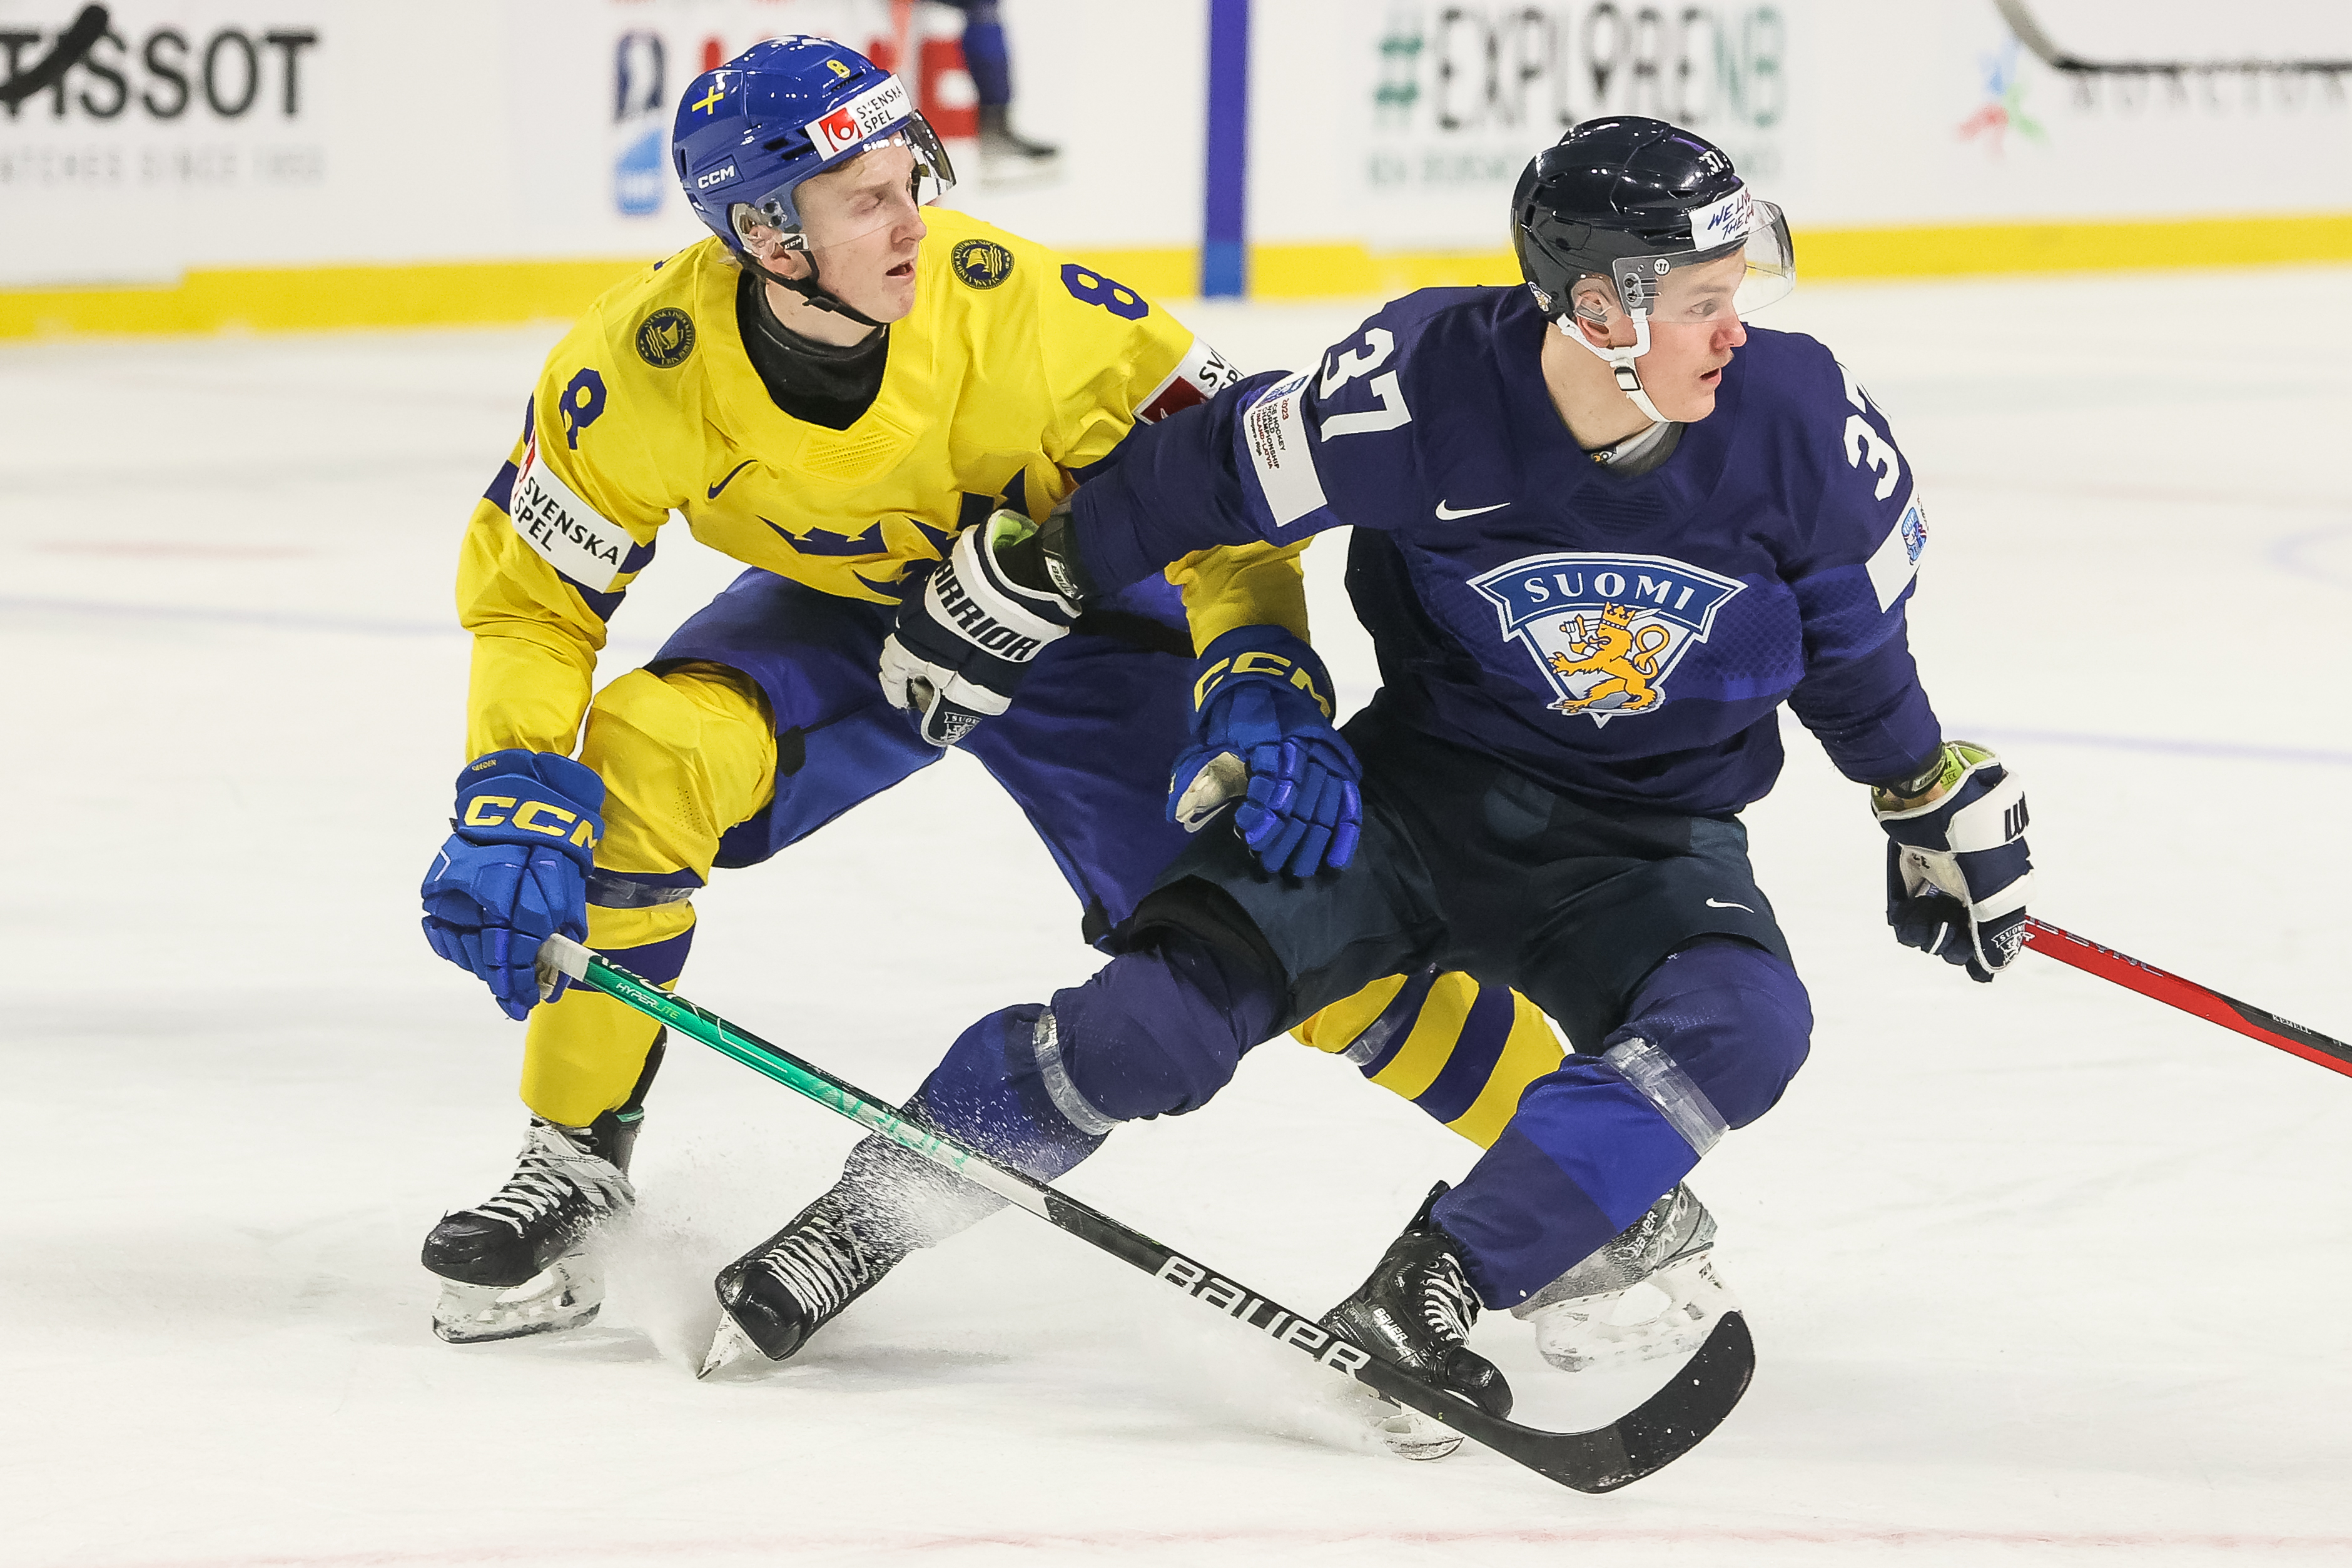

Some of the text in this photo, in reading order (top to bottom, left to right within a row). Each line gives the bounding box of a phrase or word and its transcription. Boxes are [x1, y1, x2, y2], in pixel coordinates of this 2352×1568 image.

[826, 59, 851, 79] 8
[864, 109, 895, 133] SPEL
[697, 164, 736, 189] CCM
[1706, 203, 1734, 231] WE
[1061, 263, 1149, 321] 8
[1319, 326, 1413, 443] 37
[1261, 407, 1280, 469] CHAMPIONSHIP
[1267, 405, 1275, 434] WORLD
[1272, 416, 1286, 451] HOCKEY
[513, 497, 554, 552] SPEL
[523, 475, 620, 566] SVENSKA
[935, 559, 1042, 662] ARRIOR
[1528, 572, 1696, 611] SUOMI
[1194, 652, 1331, 719] CCM
[464, 795, 598, 849] CCM
[1999, 923, 2025, 941] SUOM
[616, 982, 681, 1019] HYPERLITE
